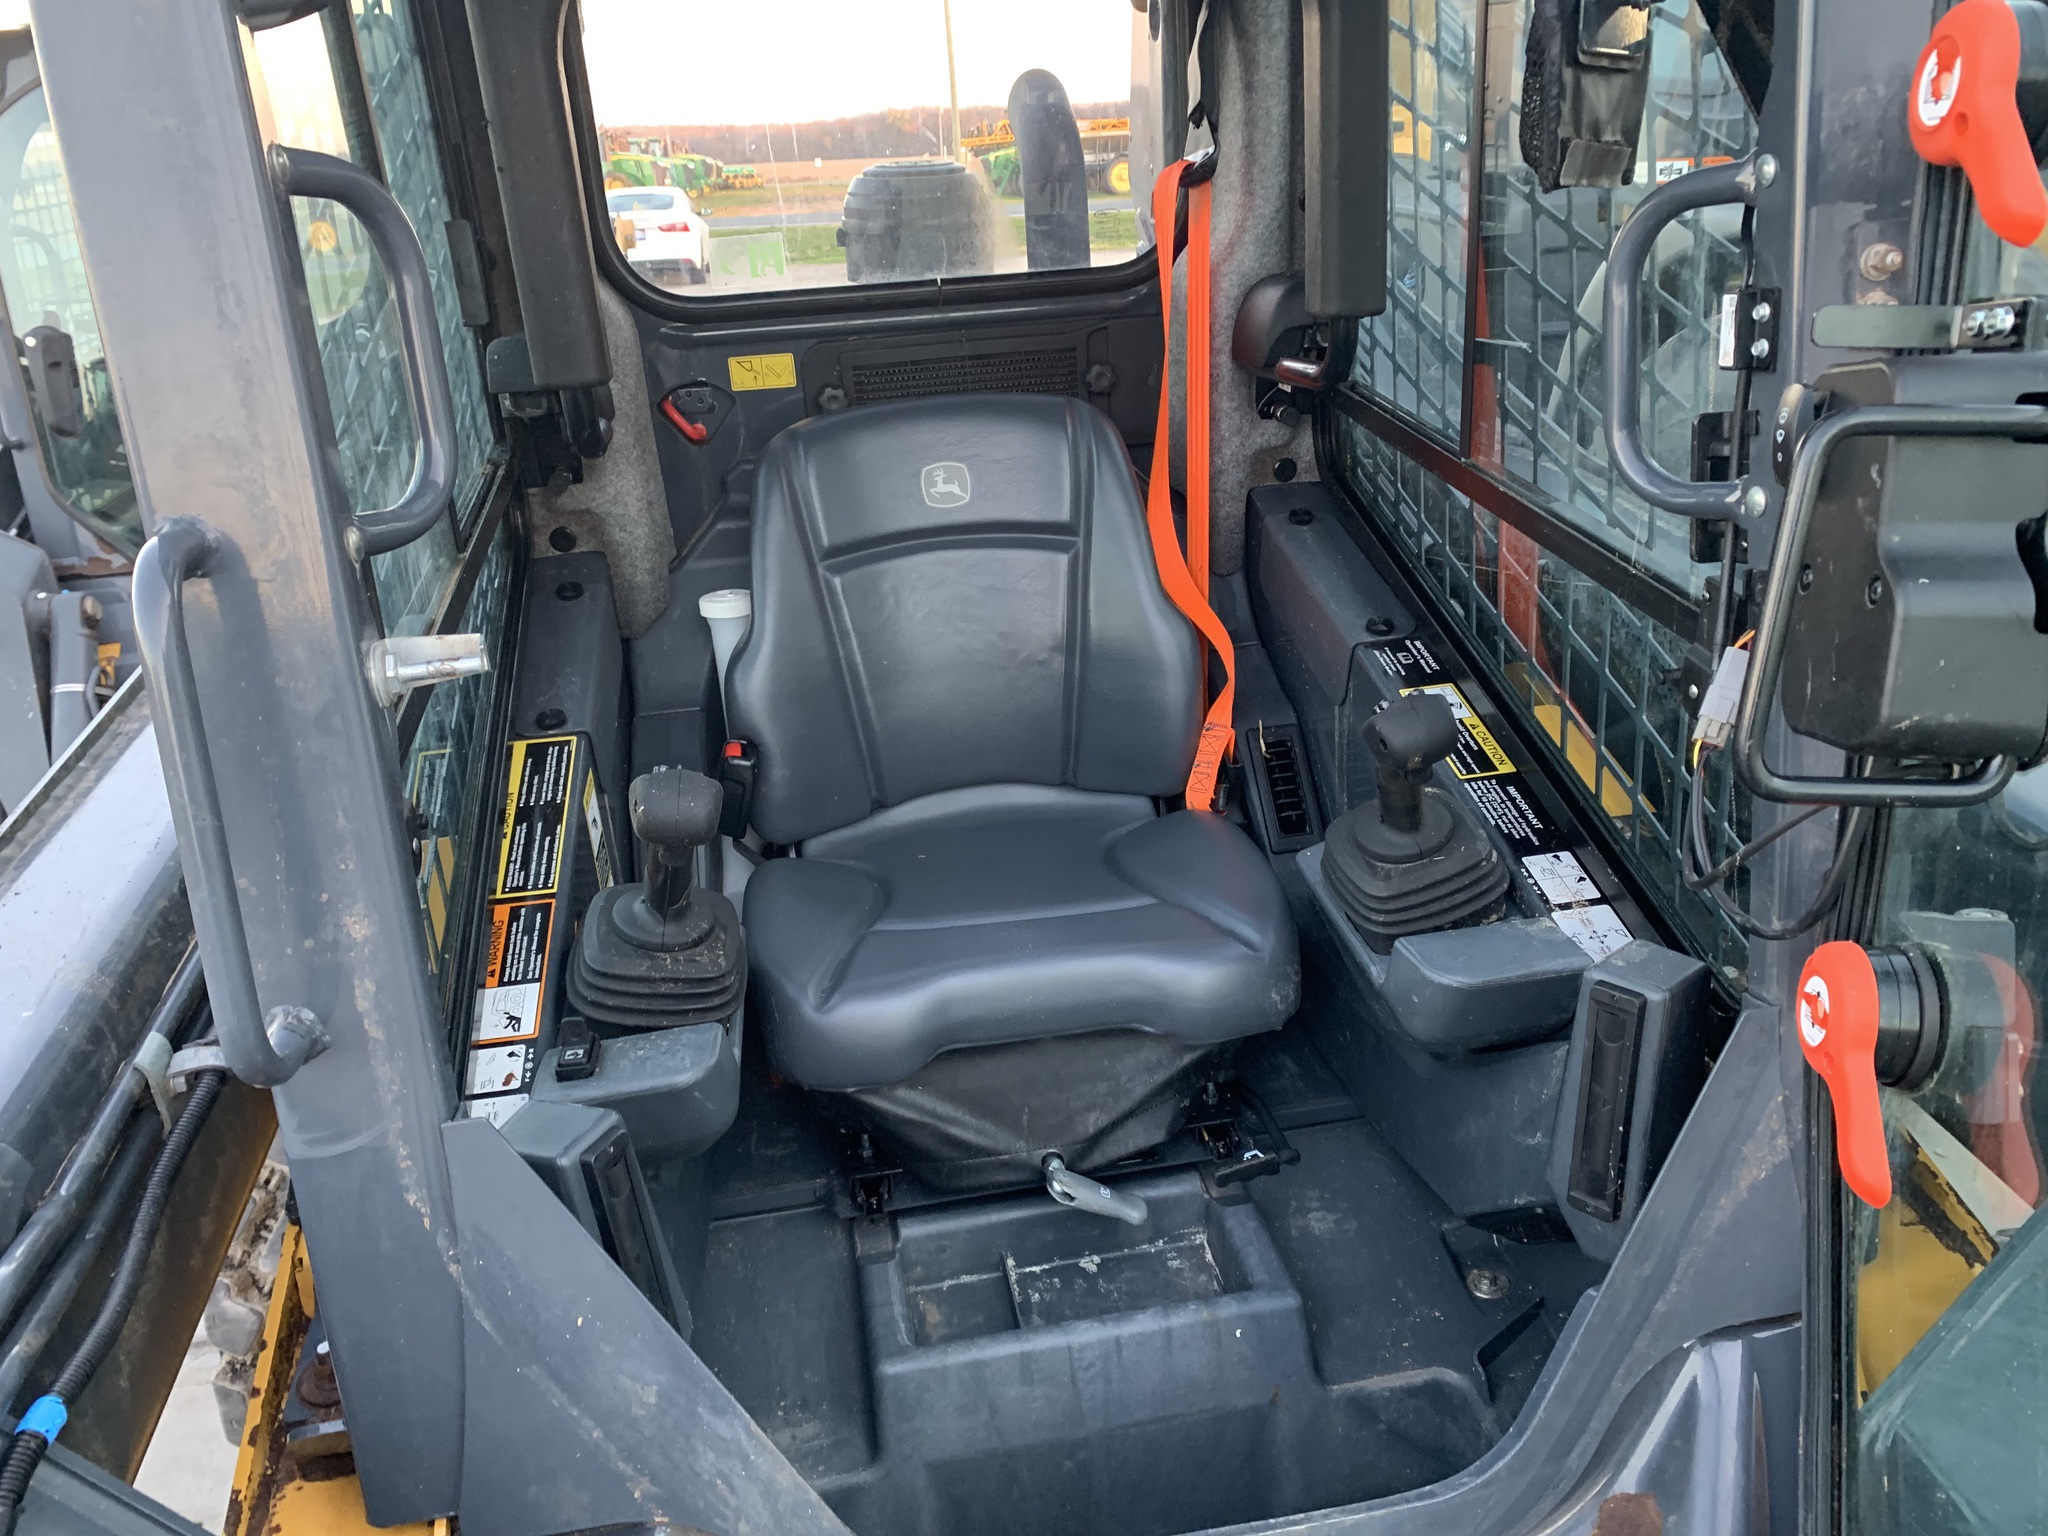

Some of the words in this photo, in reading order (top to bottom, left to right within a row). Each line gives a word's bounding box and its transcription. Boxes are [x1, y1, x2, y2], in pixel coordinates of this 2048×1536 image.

[1414, 640, 1440, 669] IMPORTANT
[1476, 731, 1508, 765] CAUTION
[1506, 786, 1543, 828] IMPORTANT
[488, 919, 504, 966] WARNING
